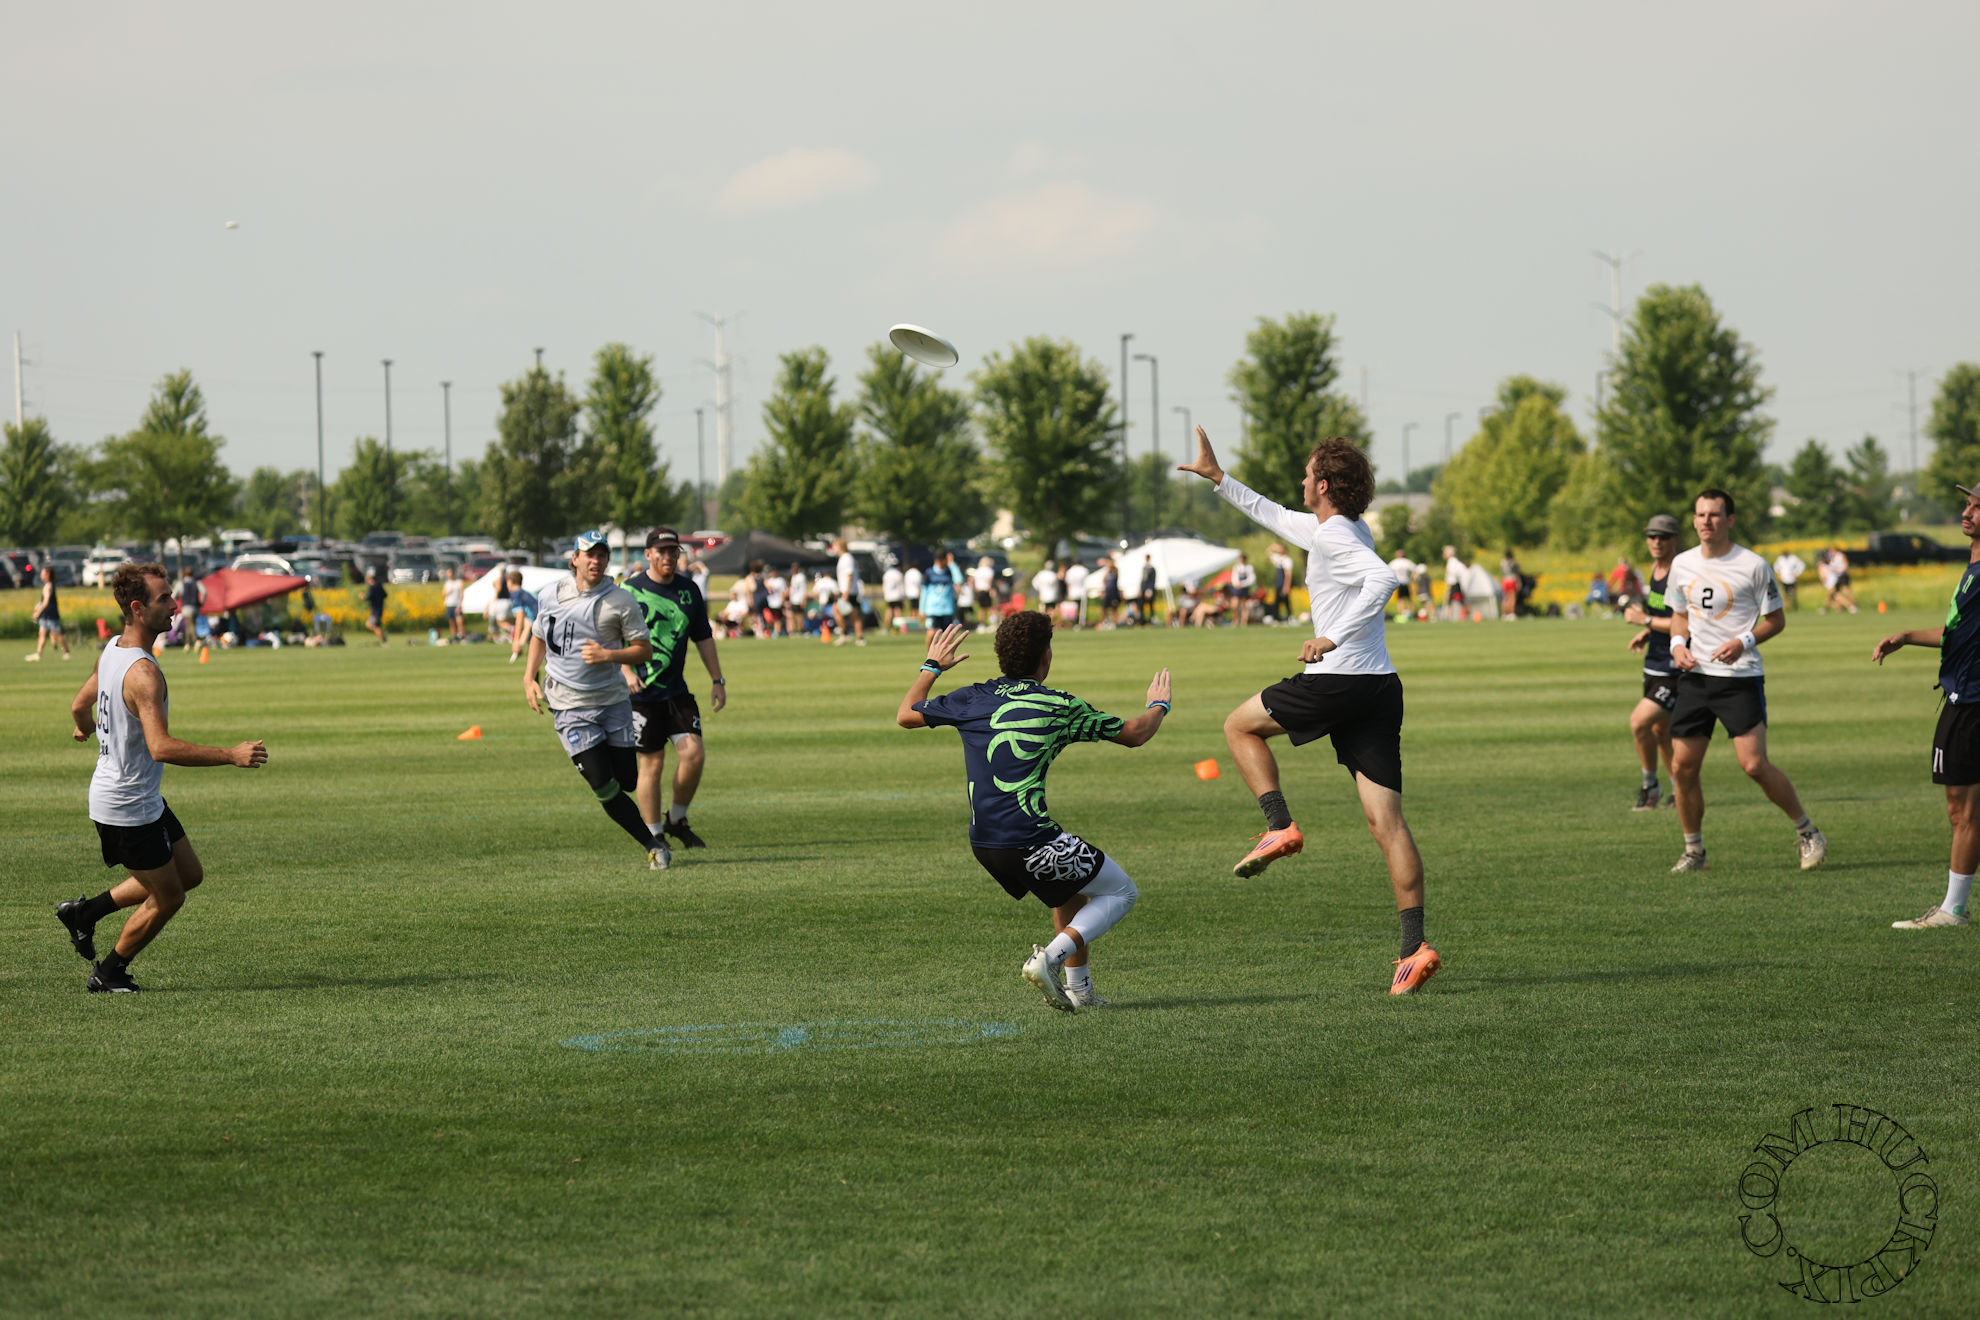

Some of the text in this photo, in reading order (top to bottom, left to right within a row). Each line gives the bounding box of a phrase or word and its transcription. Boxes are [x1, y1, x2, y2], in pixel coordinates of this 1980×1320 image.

[677, 590, 692, 605] 23
[1702, 588, 1714, 609] 2
[1654, 686, 1671, 701] 22
[1933, 747, 1944, 774] 11
